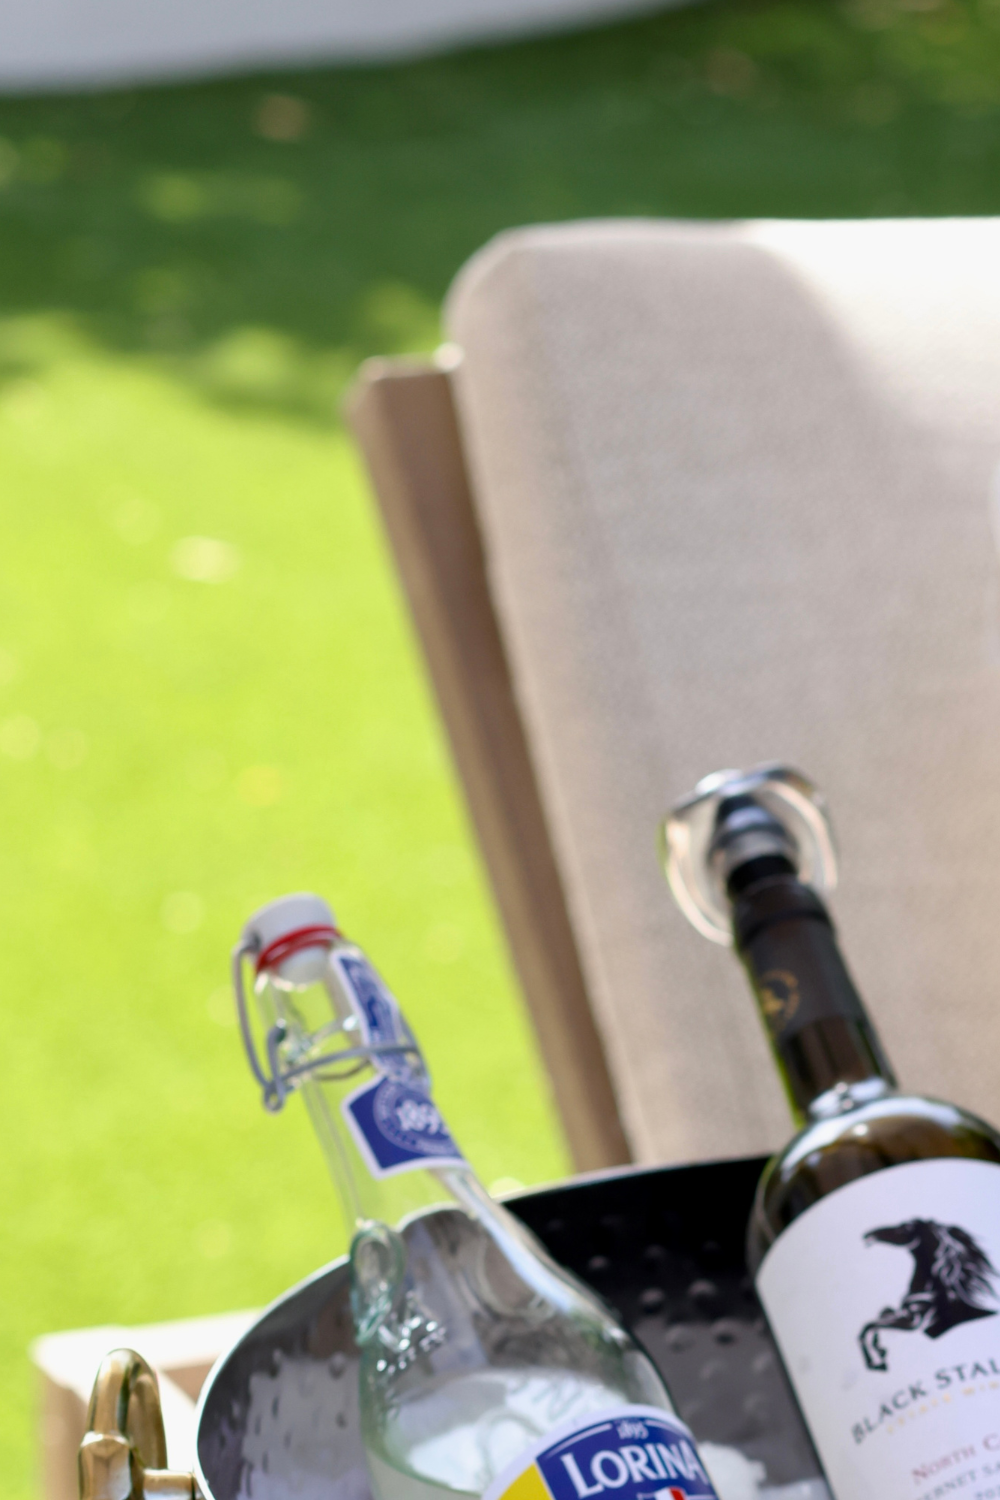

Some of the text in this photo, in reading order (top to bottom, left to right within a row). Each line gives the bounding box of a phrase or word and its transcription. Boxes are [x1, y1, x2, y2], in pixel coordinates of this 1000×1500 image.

[851, 1381, 928, 1444] BLACK
[560, 1440, 708, 1498] LORINA
[913, 1446, 976, 1485] NORTH
